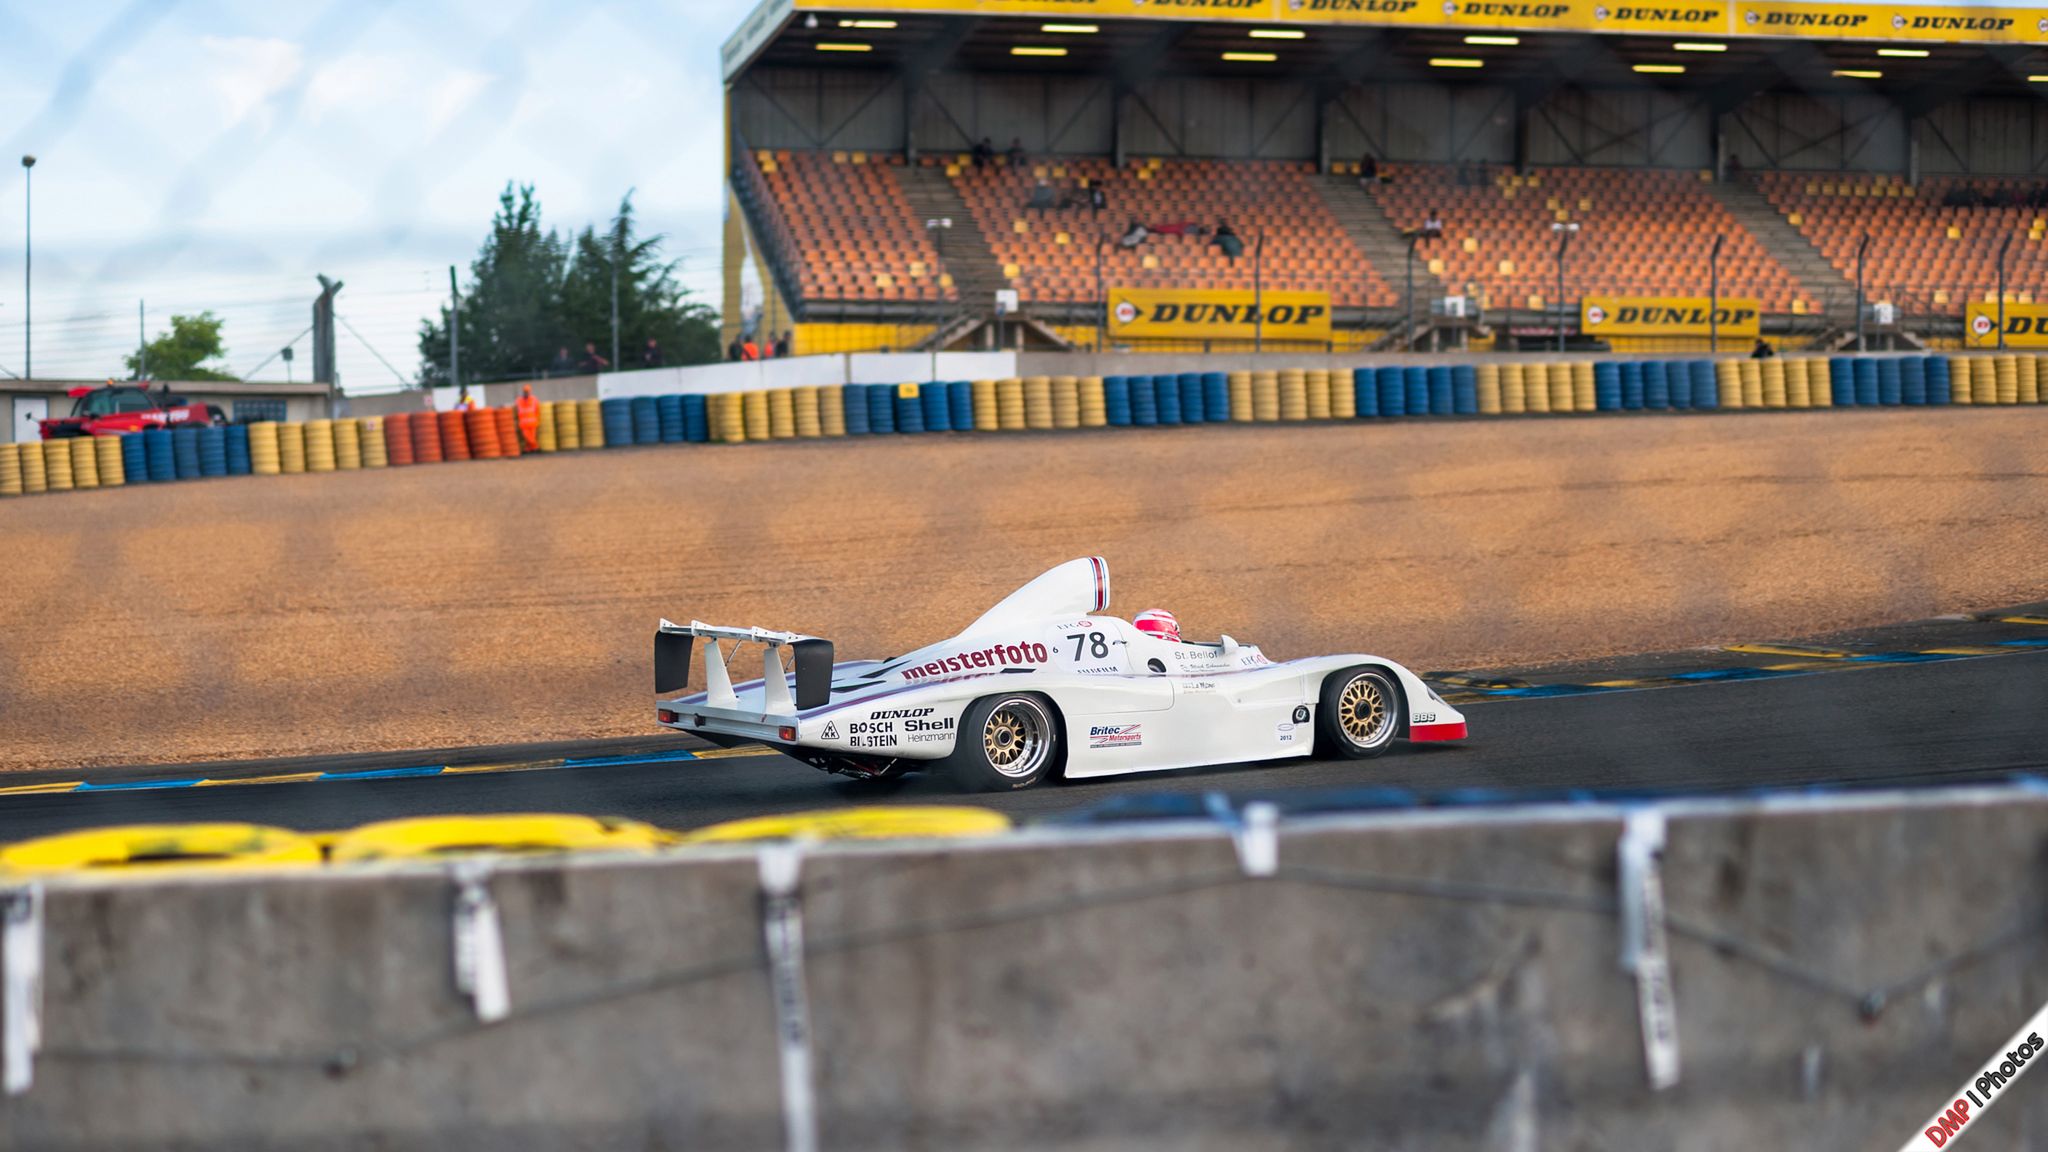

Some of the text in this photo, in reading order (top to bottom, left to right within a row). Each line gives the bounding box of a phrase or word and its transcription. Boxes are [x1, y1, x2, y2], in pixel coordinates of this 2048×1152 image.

[1310, 0, 1417, 12] DUNLOP
[1464, 2, 1569, 17] DUNLOP
[1615, 7, 1718, 22] DUNLOP
[1764, 12, 1867, 27] DUNLOP
[1912, 16, 2014, 30] DUNLOP
[1150, 303, 1323, 324] DUNLOP
[1614, 307, 1754, 325] DUNLOP
[1066, 631, 1109, 662] 78
[901, 640, 1048, 680] meisterfoto
[870, 707, 935, 720] DUNLOP
[1412, 712, 1436, 723] BBS
[849, 722, 893, 734] BOSCH
[904, 717, 954, 732] Shell
[1090, 726, 1121, 736] Britec
[907, 731, 956, 743] Heinzmann
